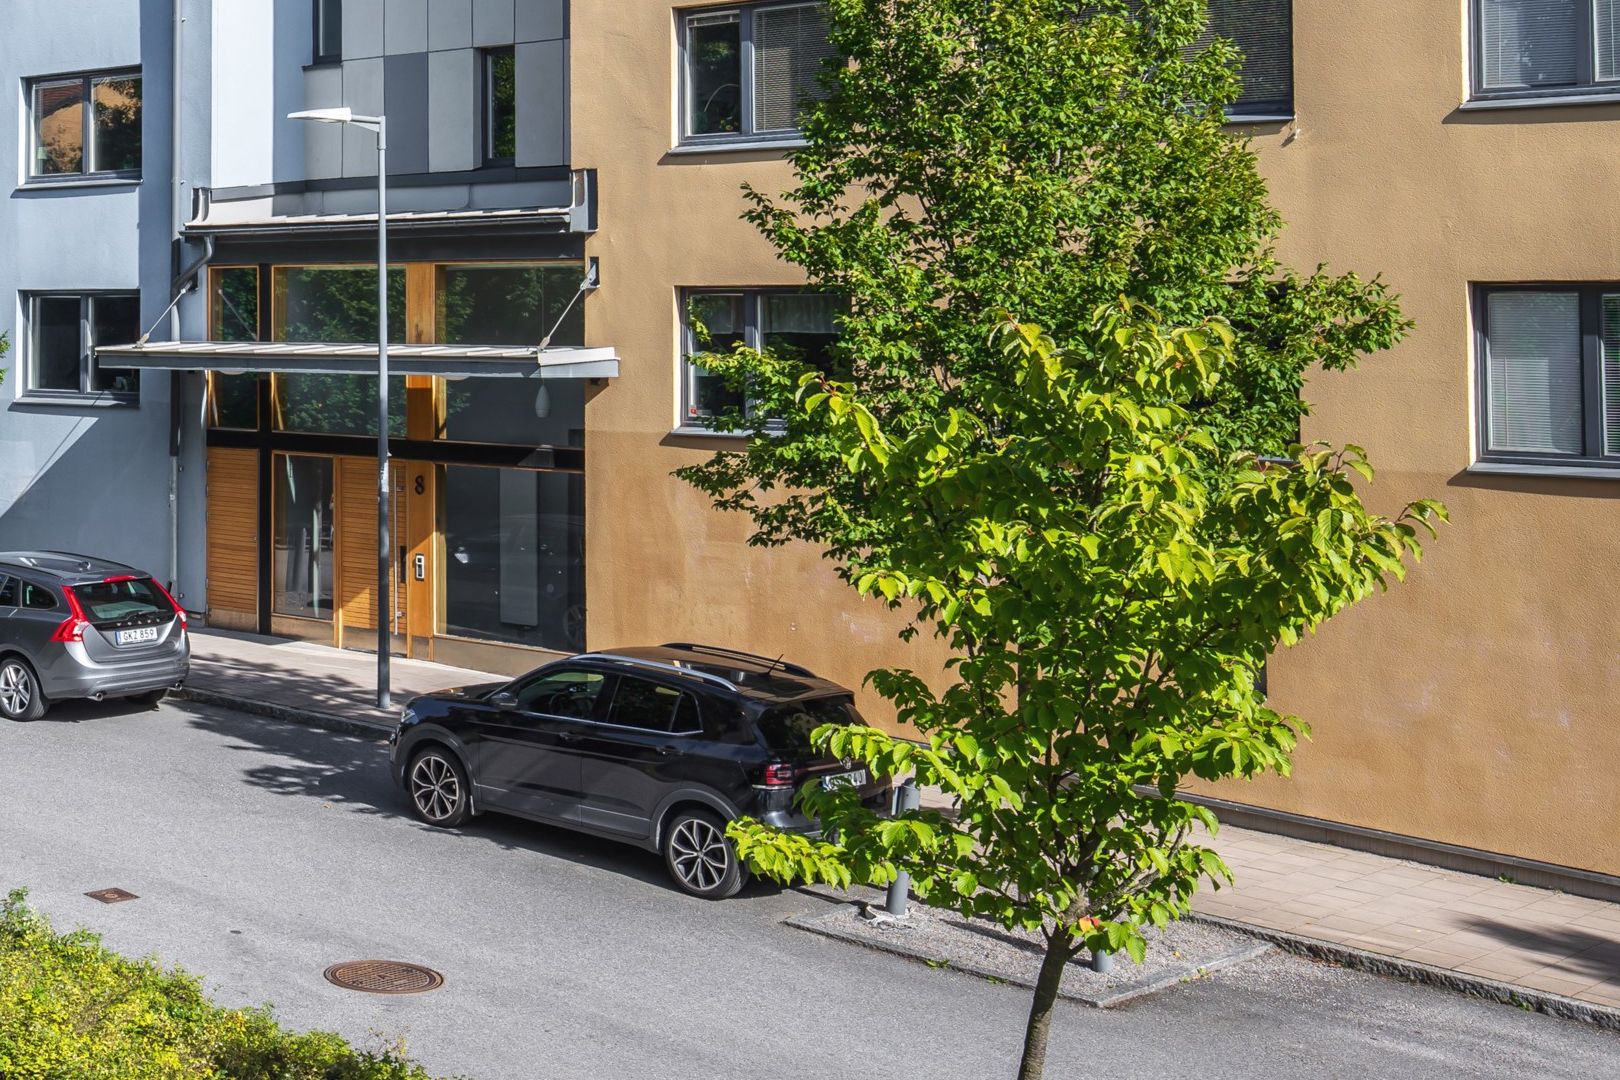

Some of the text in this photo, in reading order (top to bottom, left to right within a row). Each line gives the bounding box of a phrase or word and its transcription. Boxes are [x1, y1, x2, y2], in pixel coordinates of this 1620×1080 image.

[414, 475, 425, 496] 8
[116, 618, 160, 627] VOLVO
[123, 629, 154, 641] GKZ 859
